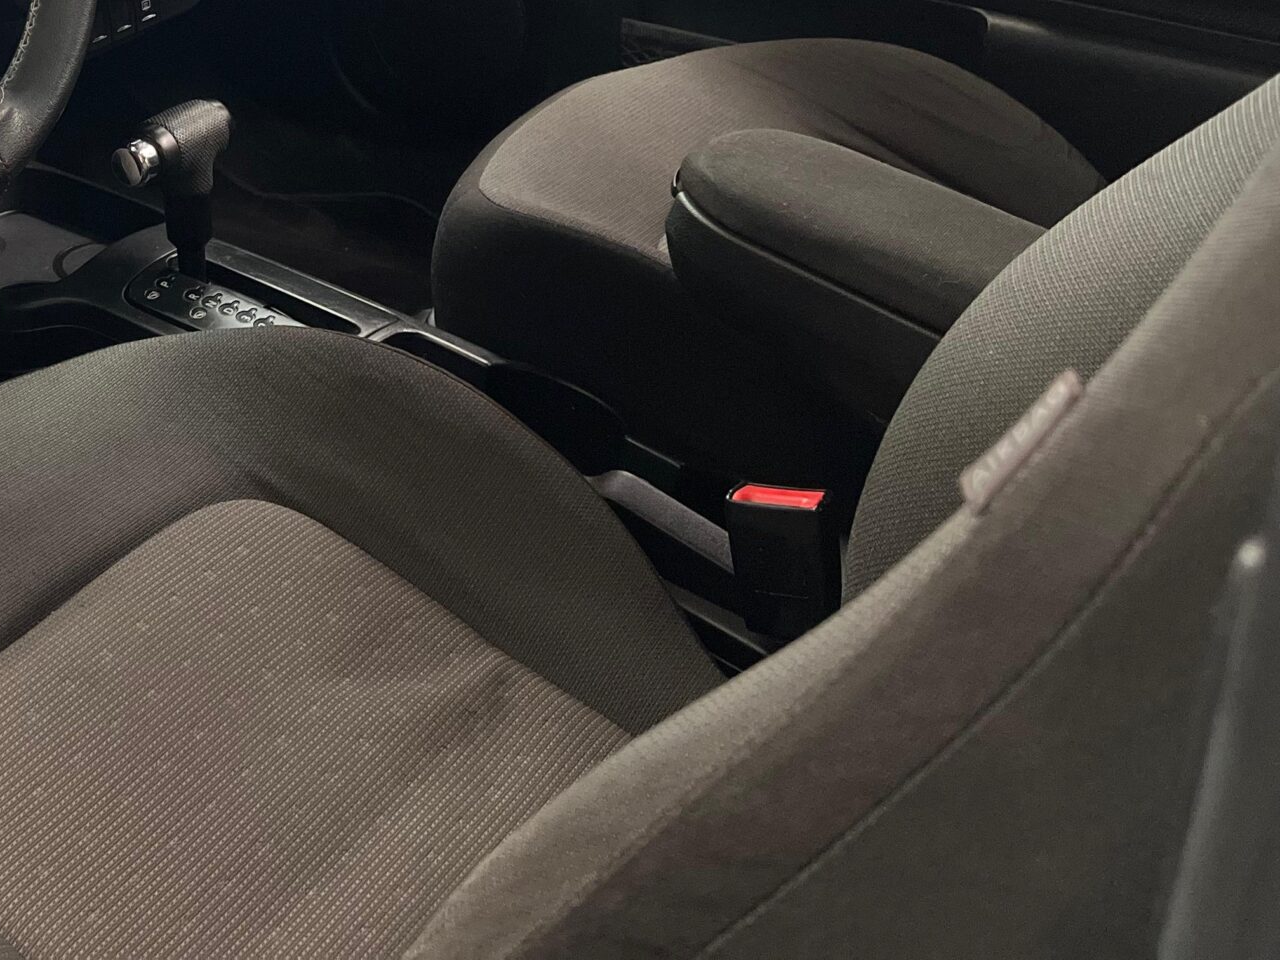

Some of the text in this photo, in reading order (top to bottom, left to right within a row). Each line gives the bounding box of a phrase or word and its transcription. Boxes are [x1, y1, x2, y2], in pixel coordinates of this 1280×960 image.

[160, 280, 169, 288] P
[188, 293, 199, 301] R
[223, 307, 234, 316] D
